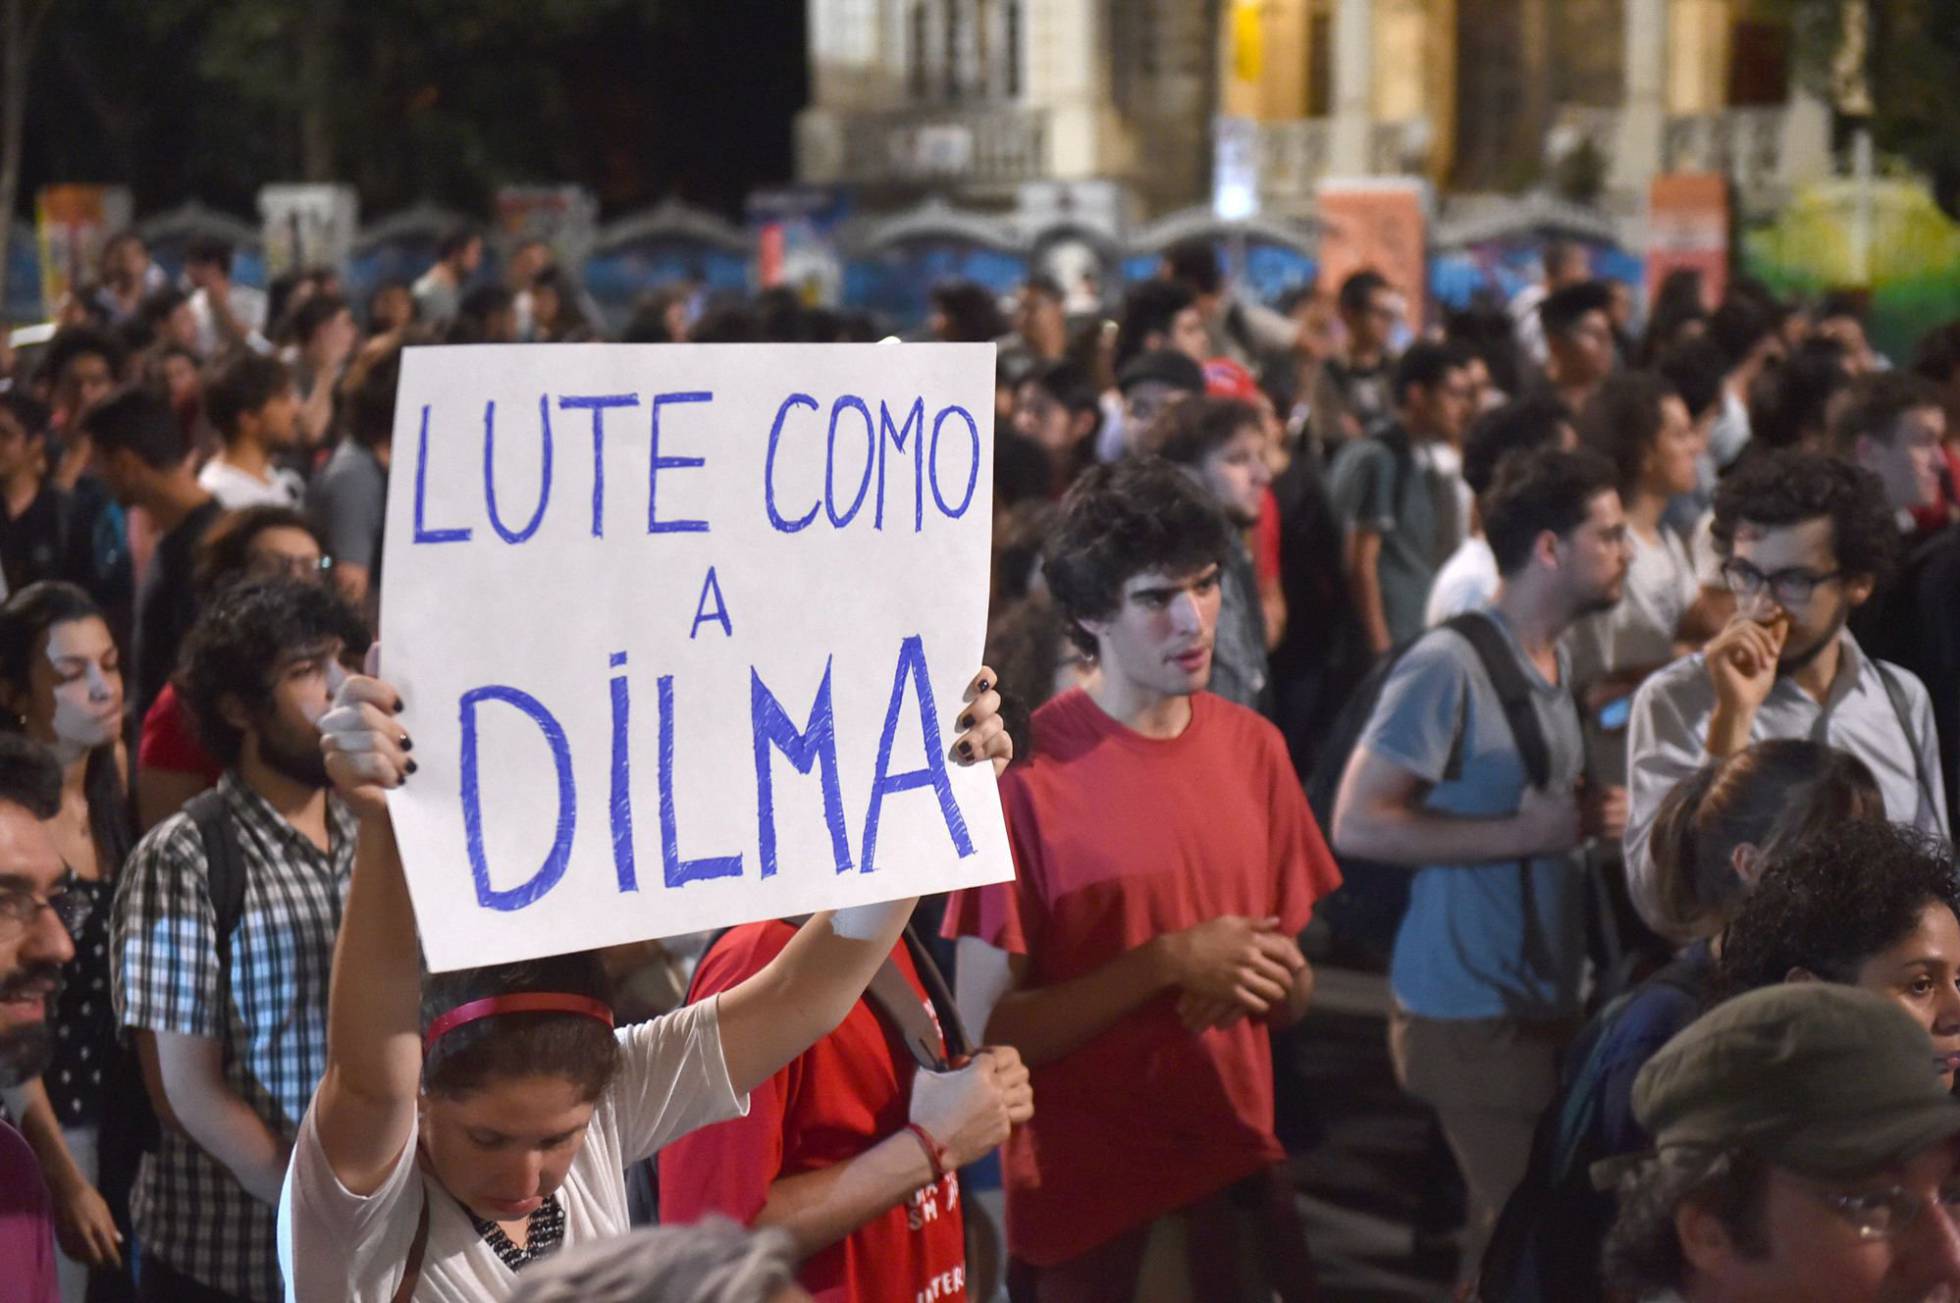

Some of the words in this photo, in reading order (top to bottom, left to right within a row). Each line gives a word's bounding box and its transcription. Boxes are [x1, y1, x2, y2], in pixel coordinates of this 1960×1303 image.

[413, 391, 714, 544] LUTE
[765, 393, 980, 533] COMO
[690, 566, 732, 638] A
